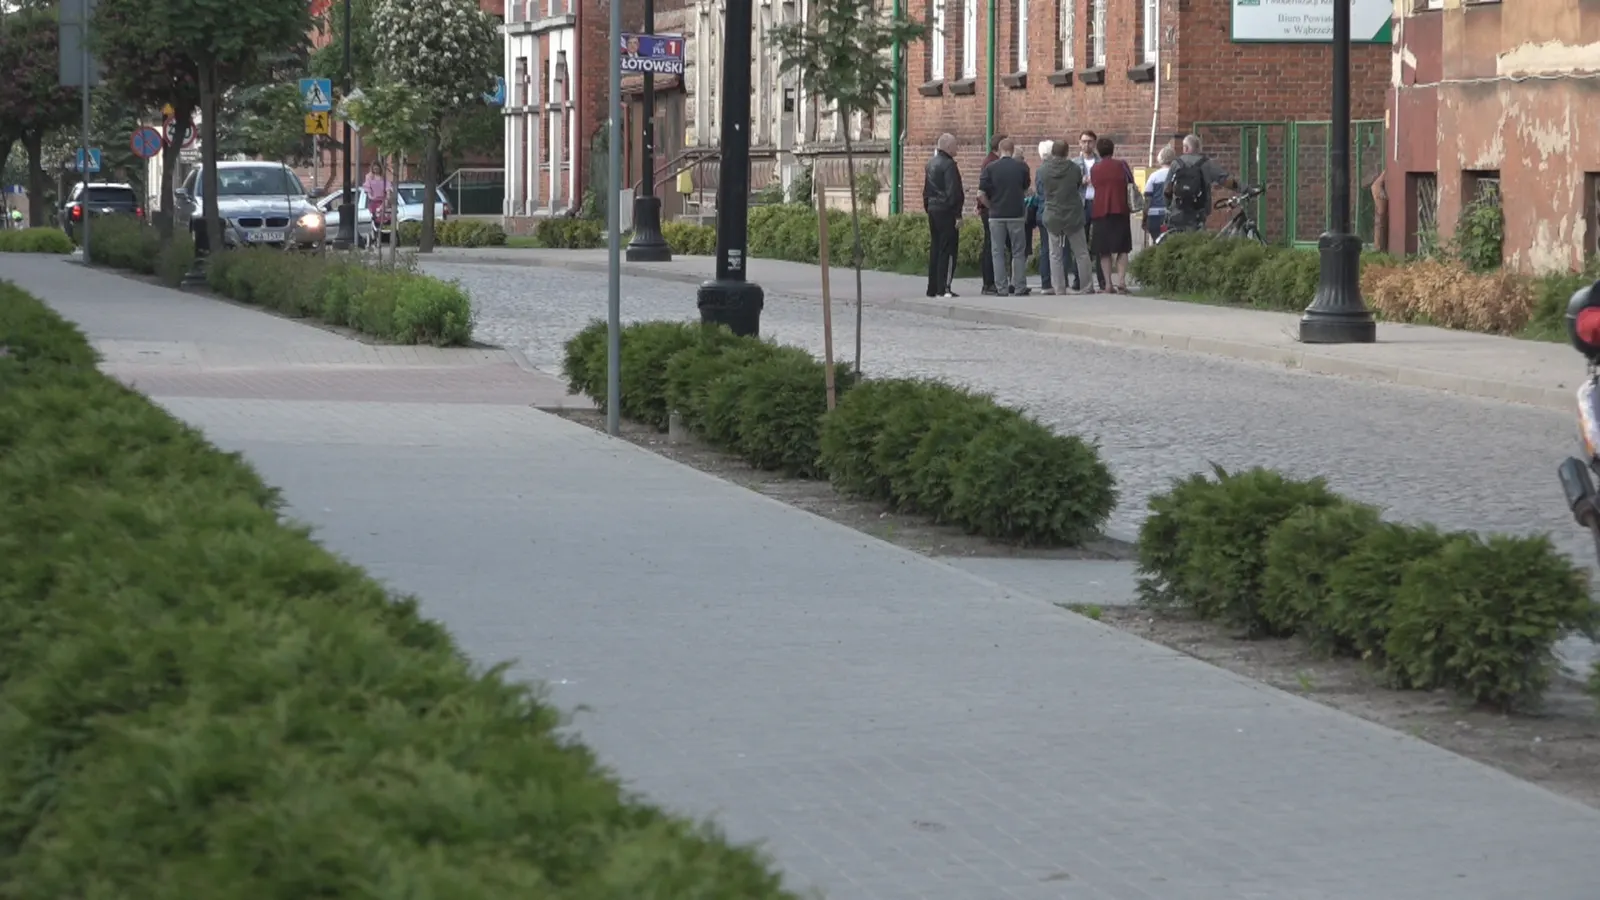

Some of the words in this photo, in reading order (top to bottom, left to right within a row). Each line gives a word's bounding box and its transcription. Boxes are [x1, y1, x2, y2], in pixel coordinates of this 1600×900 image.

[1277, 13, 1301, 23] Biuro
[1303, 13, 1334, 23] Powiat
[669, 41, 676, 54] 1
[621, 58, 683, 74] ŁOTOWSKI
